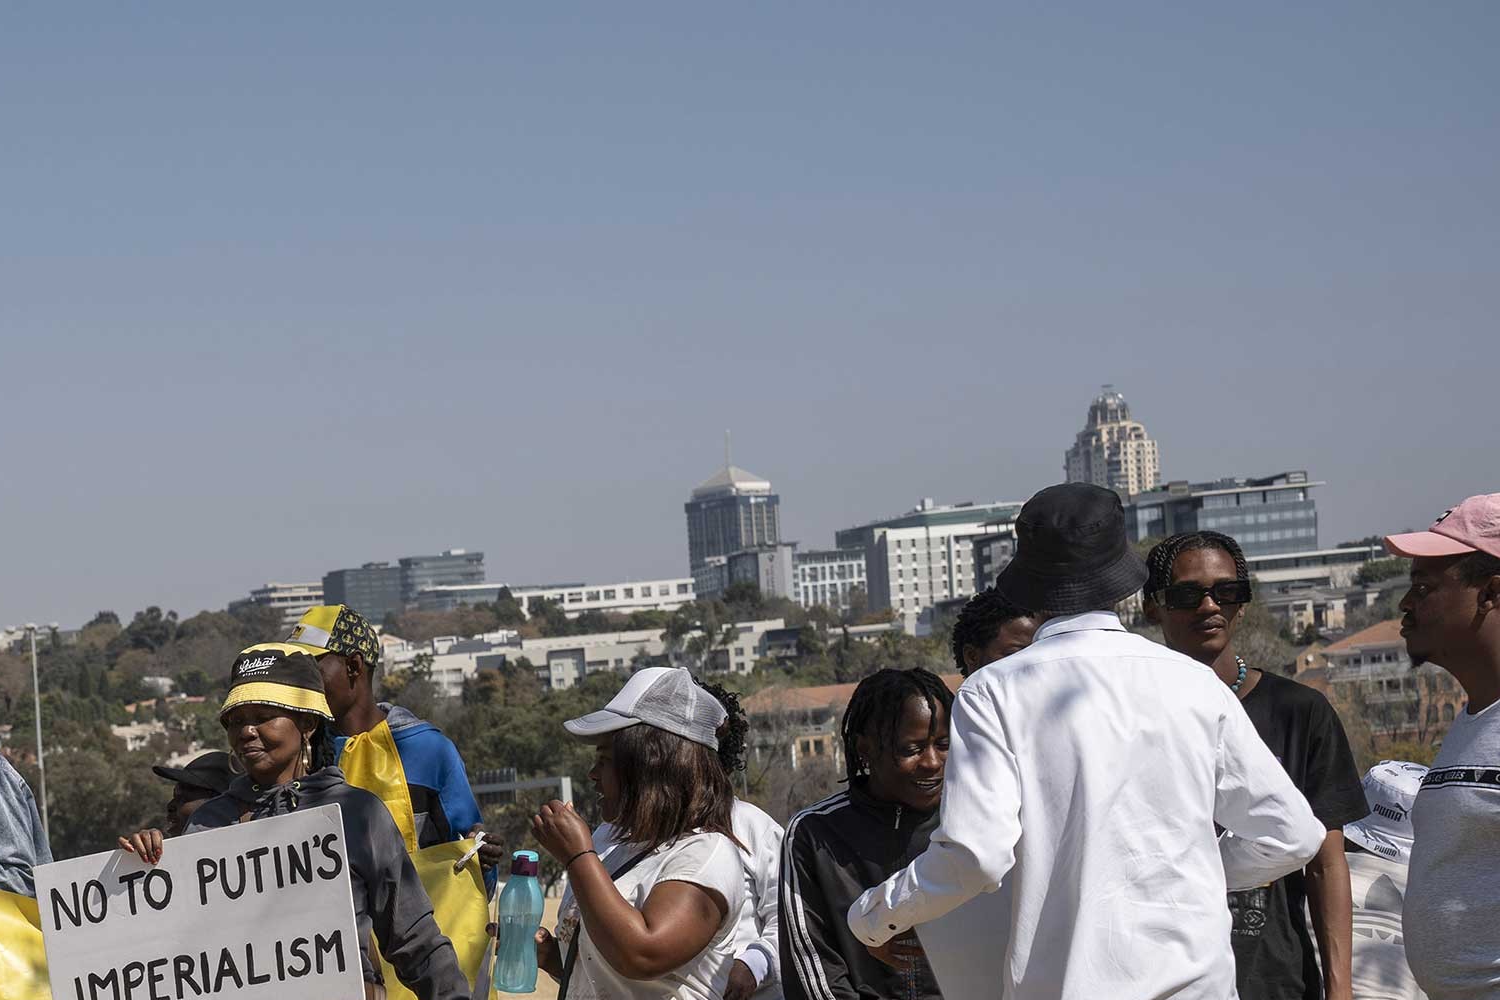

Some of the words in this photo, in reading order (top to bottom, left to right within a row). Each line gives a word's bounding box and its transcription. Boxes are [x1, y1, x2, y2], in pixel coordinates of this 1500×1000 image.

[1373, 803, 1403, 822] PUMA
[1374, 844, 1397, 857] PUMA
[50, 879, 108, 930] NO
[119, 869, 173, 915] TO
[196, 833, 343, 905] PUTIN'S
